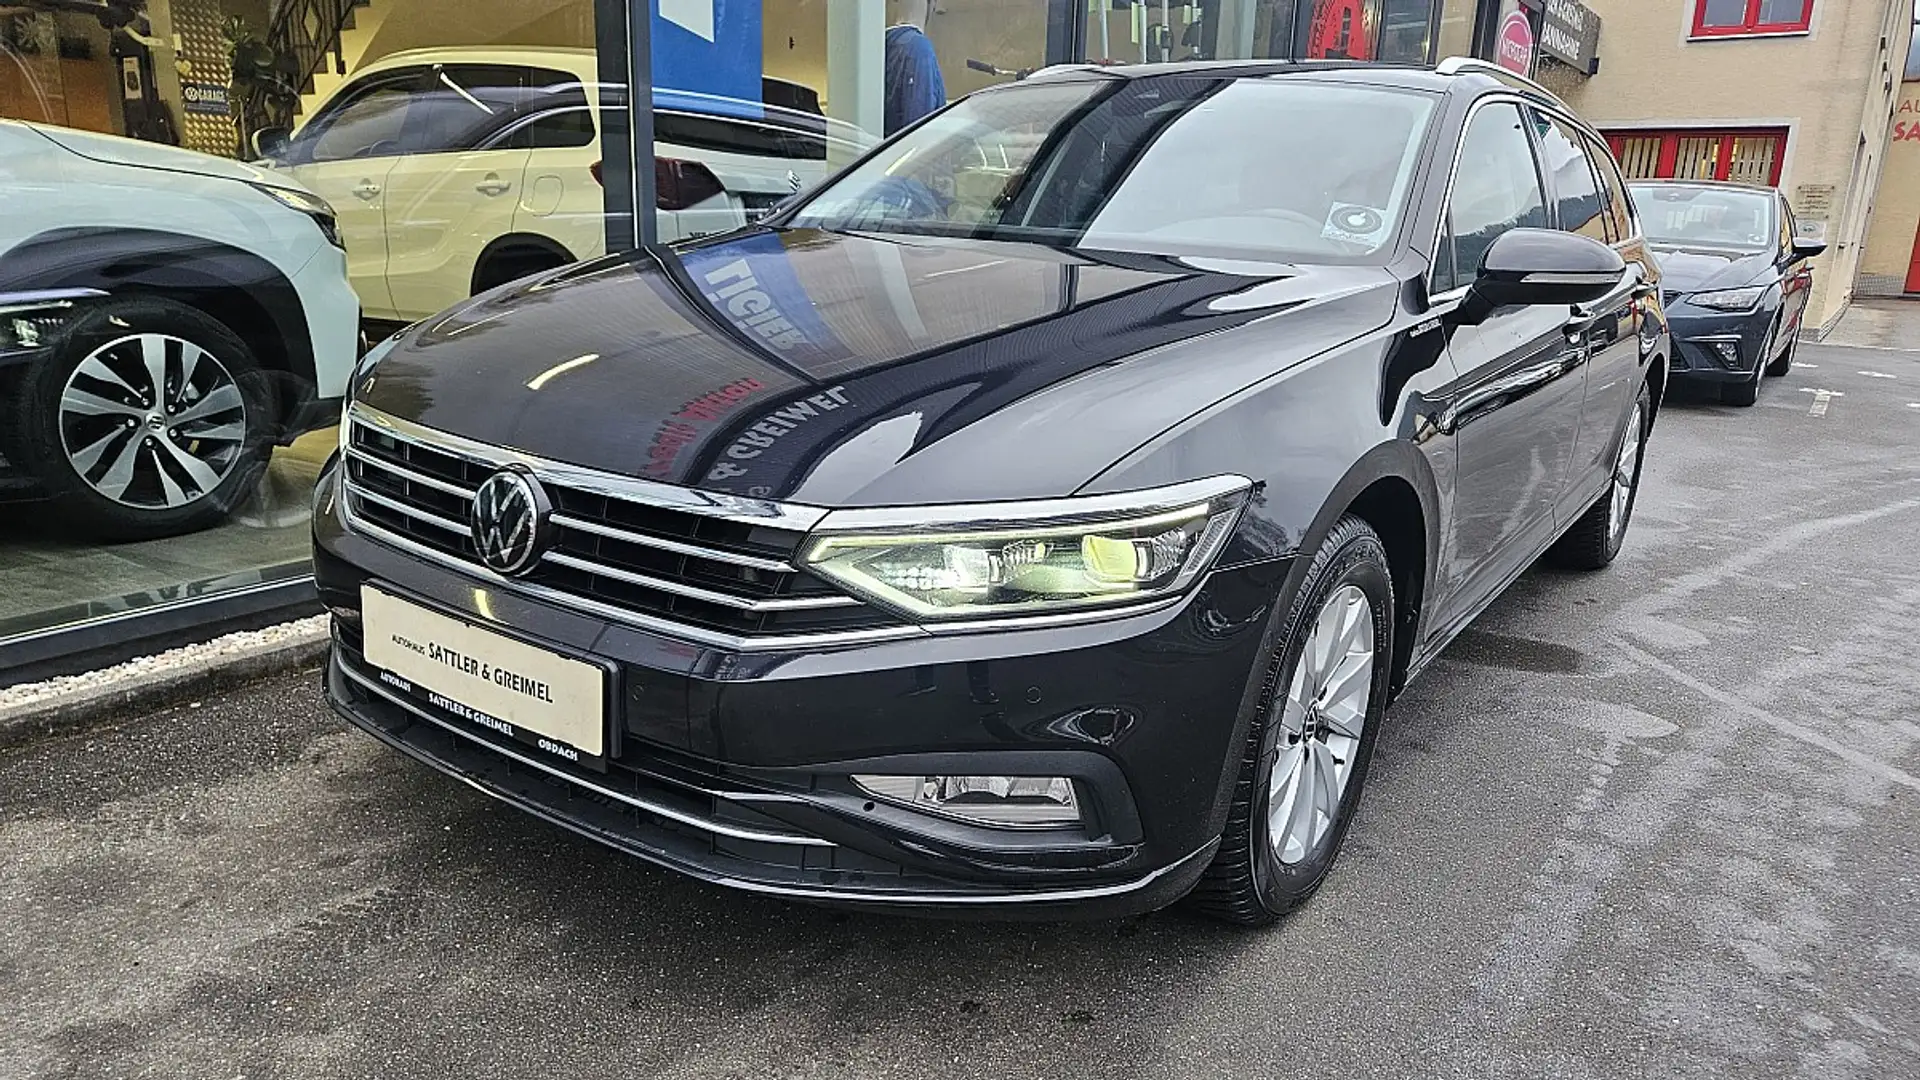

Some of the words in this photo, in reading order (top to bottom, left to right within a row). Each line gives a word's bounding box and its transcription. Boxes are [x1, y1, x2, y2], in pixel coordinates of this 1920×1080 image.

[428, 641, 479, 677] SATTLER
[481, 663, 491, 682] &
[494, 667, 554, 704] GREIMEL
[380, 671, 412, 693] AUTOHAUS
[428, 692, 465, 716] SATTLER
[465, 708, 474, 720] &
[473, 711, 514, 737] GREIMEL
[538, 738, 579, 762] OBDACH
